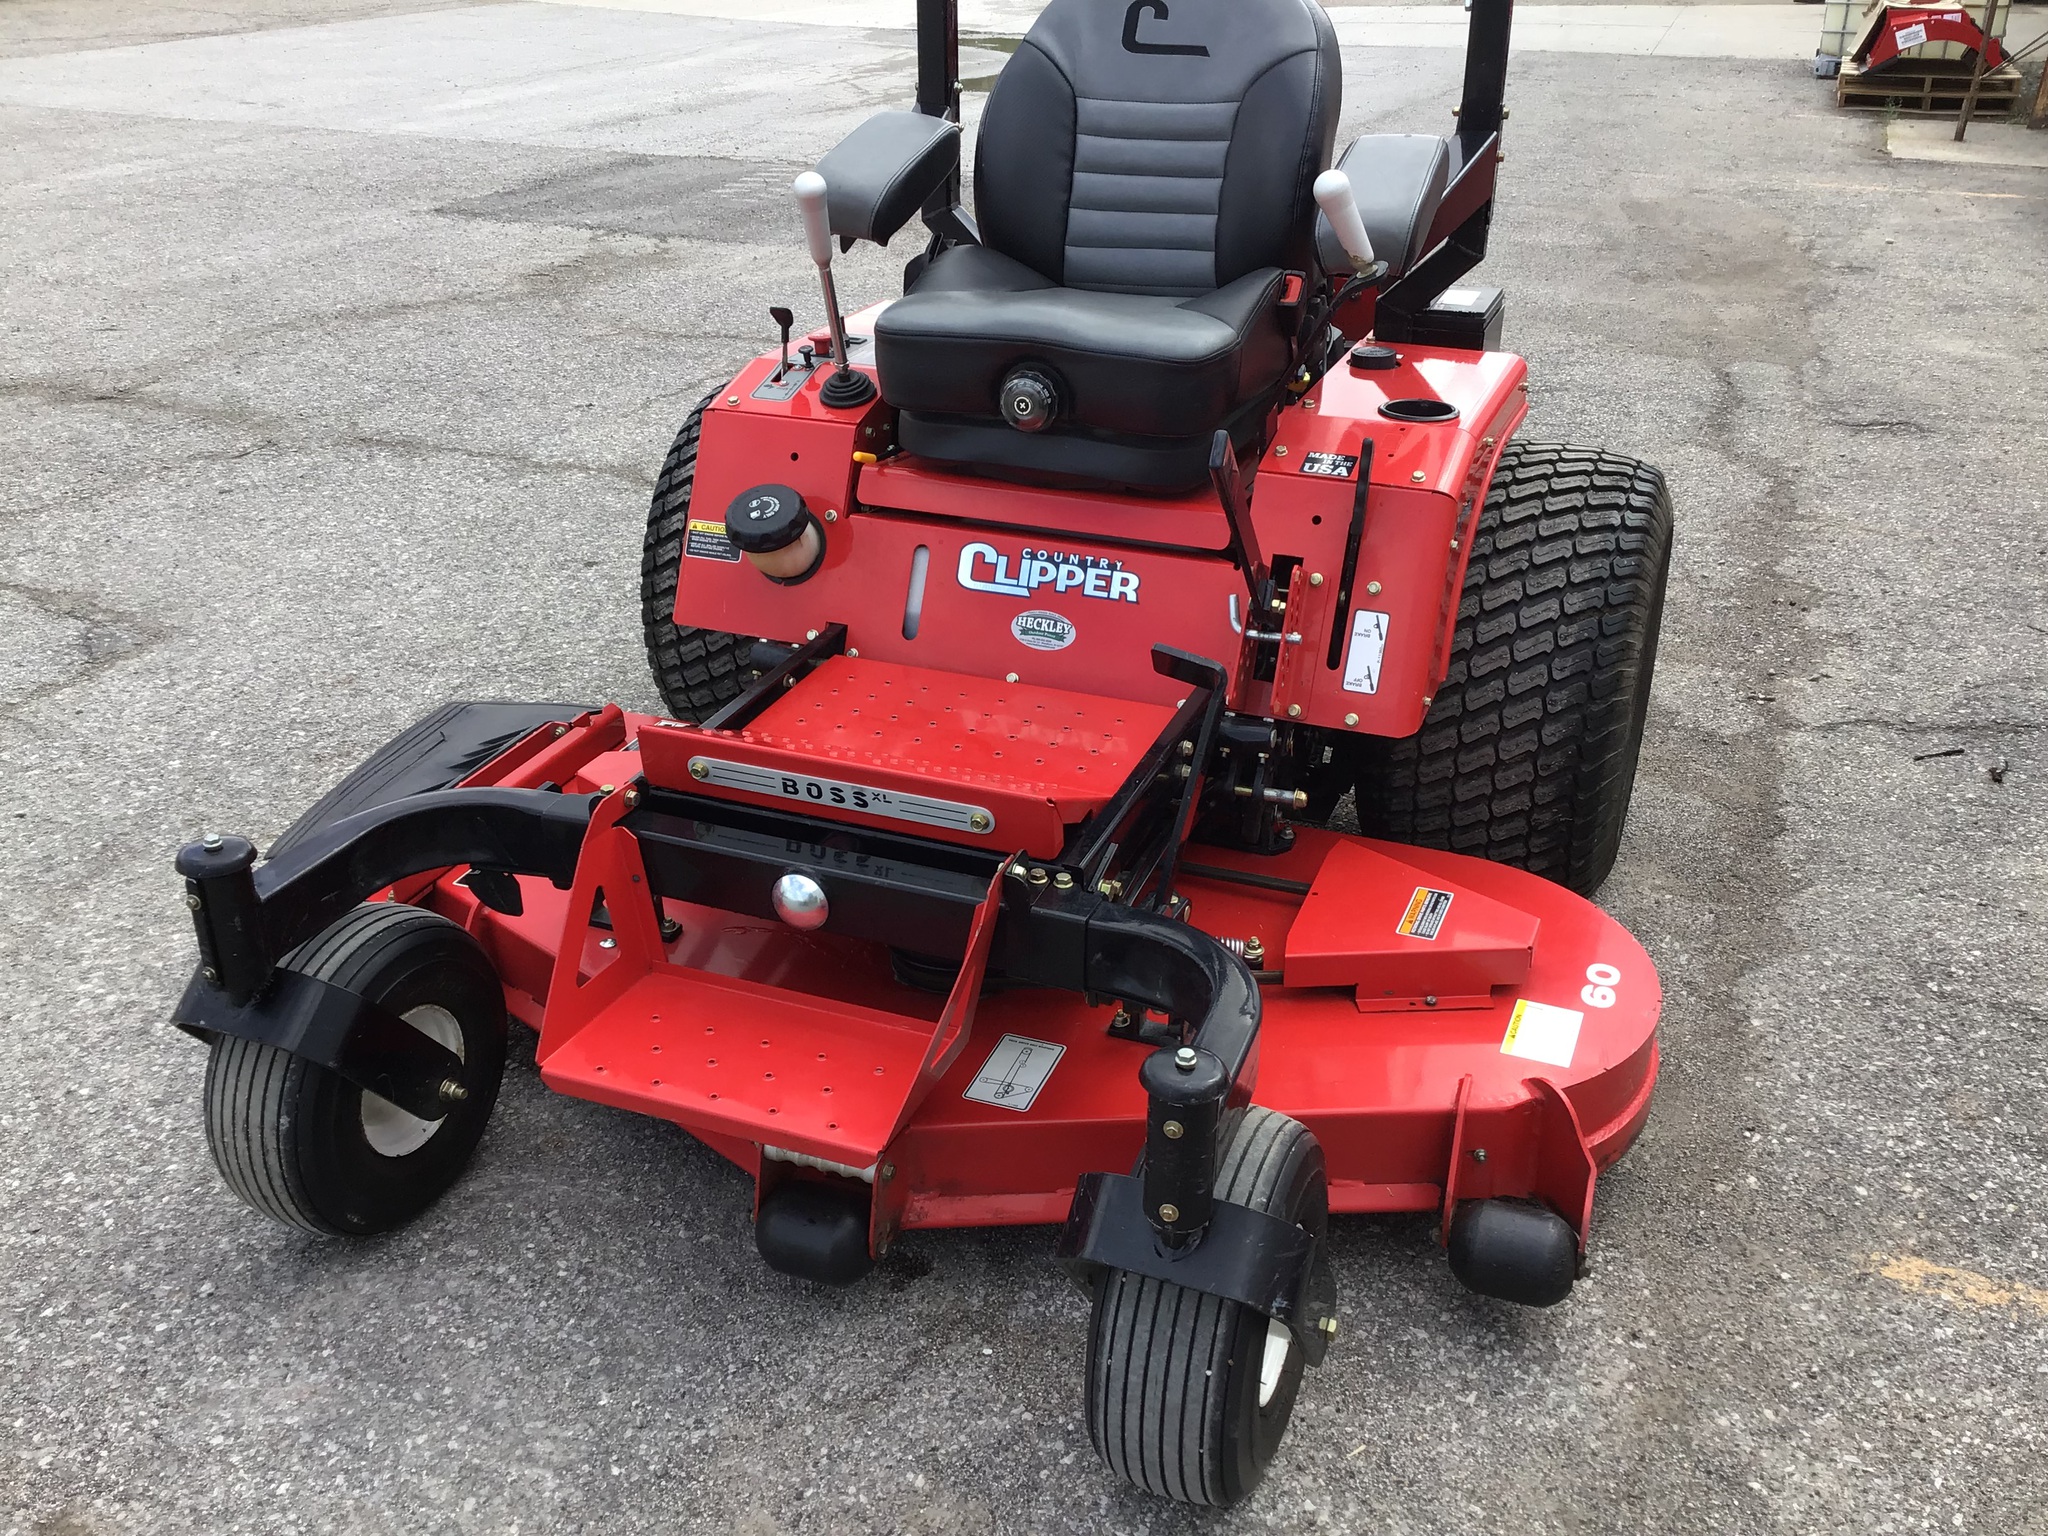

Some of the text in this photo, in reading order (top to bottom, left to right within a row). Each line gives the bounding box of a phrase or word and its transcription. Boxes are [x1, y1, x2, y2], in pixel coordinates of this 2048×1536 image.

[1308, 452, 1346, 461] MADE
[1303, 462, 1349, 477] USA
[700, 524, 725, 533] CAUTIO
[1022, 548, 1123, 571] COUNTRY
[956, 542, 1140, 603] CLIPPER
[1017, 616, 1072, 634] HECKLEY
[781, 777, 893, 809] BOSS XL
[1408, 898, 1423, 919] WARNING
[1581, 963, 1621, 1008] 60
[1509, 1014, 1523, 1035] CAUTION
